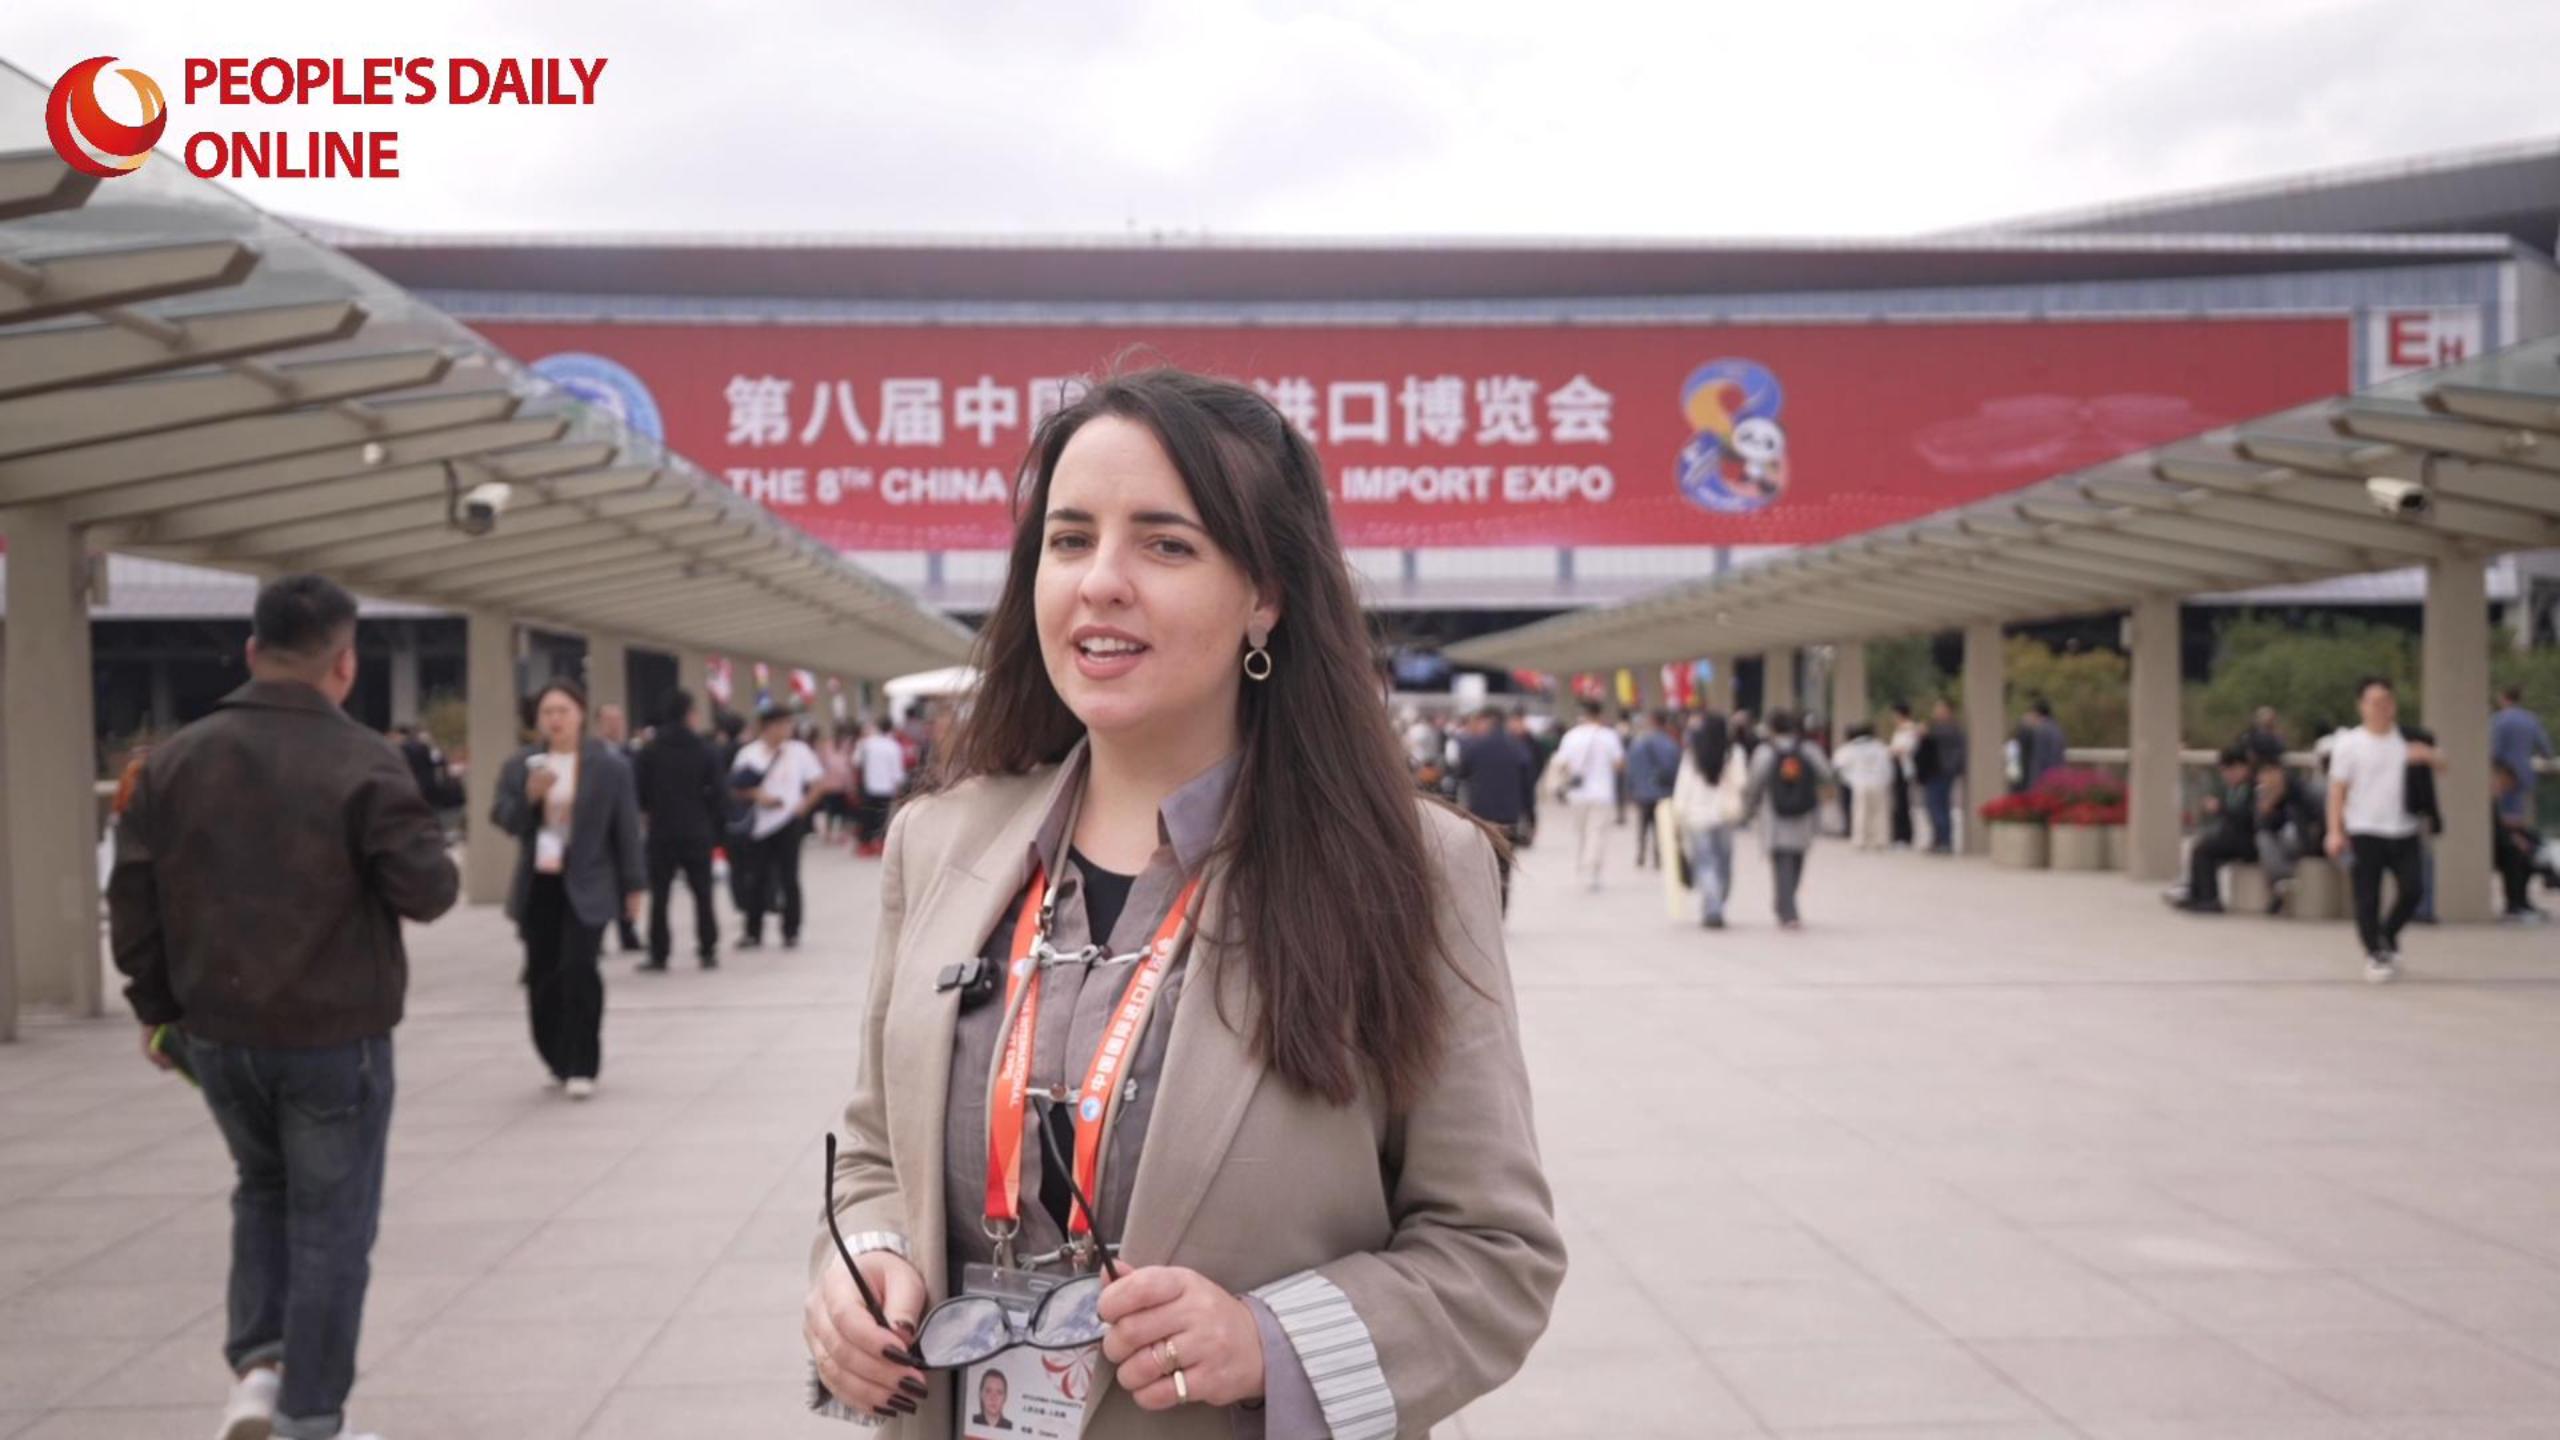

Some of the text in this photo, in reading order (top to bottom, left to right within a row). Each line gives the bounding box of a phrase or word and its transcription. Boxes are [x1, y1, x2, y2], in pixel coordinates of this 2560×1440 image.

[725, 467, 807, 504] THE
[880, 467, 1009, 504] CHINA
[1342, 466, 1493, 502] IMPORT
[1503, 466, 1614, 502] EXPO
